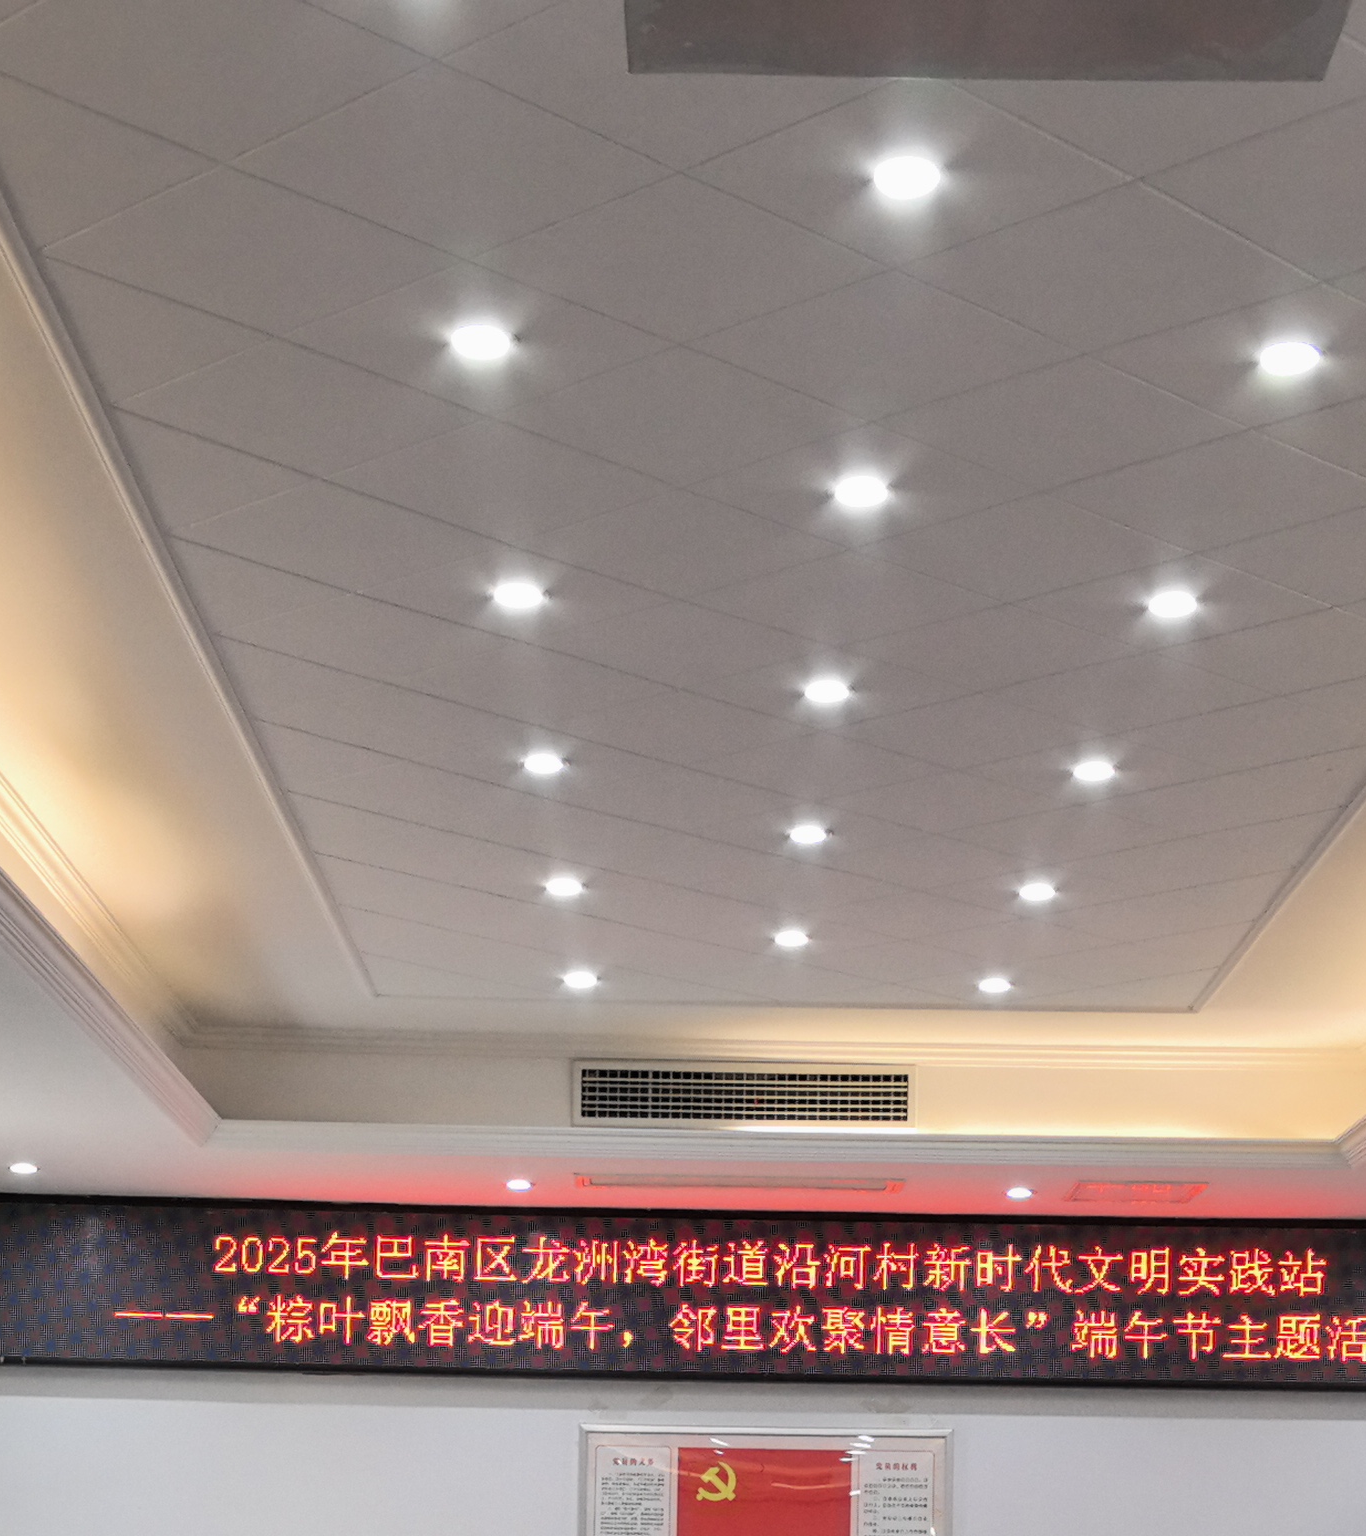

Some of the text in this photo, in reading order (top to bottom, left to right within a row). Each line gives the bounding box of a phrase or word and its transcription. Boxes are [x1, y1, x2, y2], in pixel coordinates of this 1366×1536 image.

[213, 1231, 1328, 1298] 2025年巴南区龙洲湾街道沿河村新时代文明实践站
